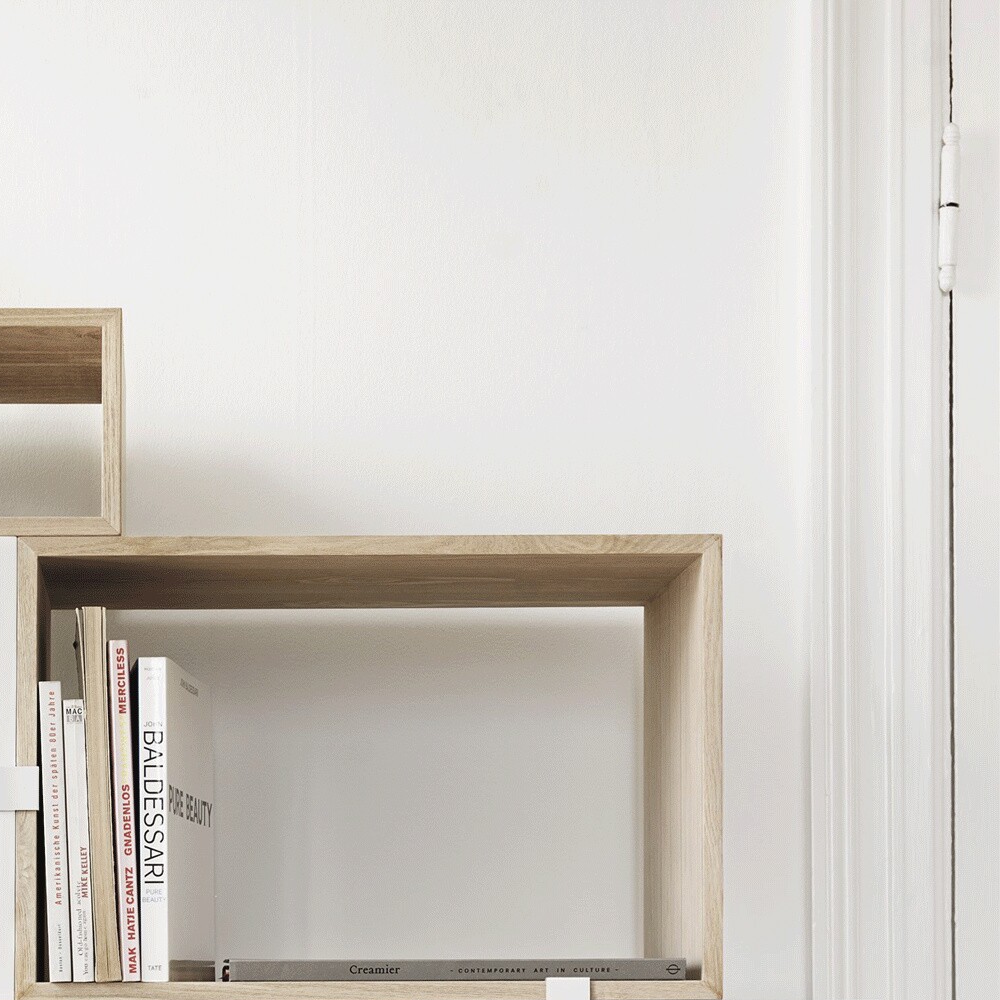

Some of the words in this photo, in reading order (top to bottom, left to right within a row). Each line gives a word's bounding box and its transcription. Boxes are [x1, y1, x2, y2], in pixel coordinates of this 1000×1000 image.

[116, 647, 127, 714] MERCILESS
[47, 690, 56, 717] Jahre
[48, 721, 57, 743] 80er
[49, 747, 58, 780] späten
[50, 783, 58, 799] der
[144, 731, 164, 884] BALDESSARI
[168, 784, 184, 818] PURE
[186, 796, 213, 828] BEAUTY
[52, 803, 60, 830] Kunst
[121, 784, 133, 856] GNADENLOS
[53, 834, 62, 906] Amerikanische
[124, 867, 134, 905] CANTZ
[126, 907, 136, 940] HATJE
[128, 947, 137, 974] MAK
[349, 965, 400, 974] Creamier
